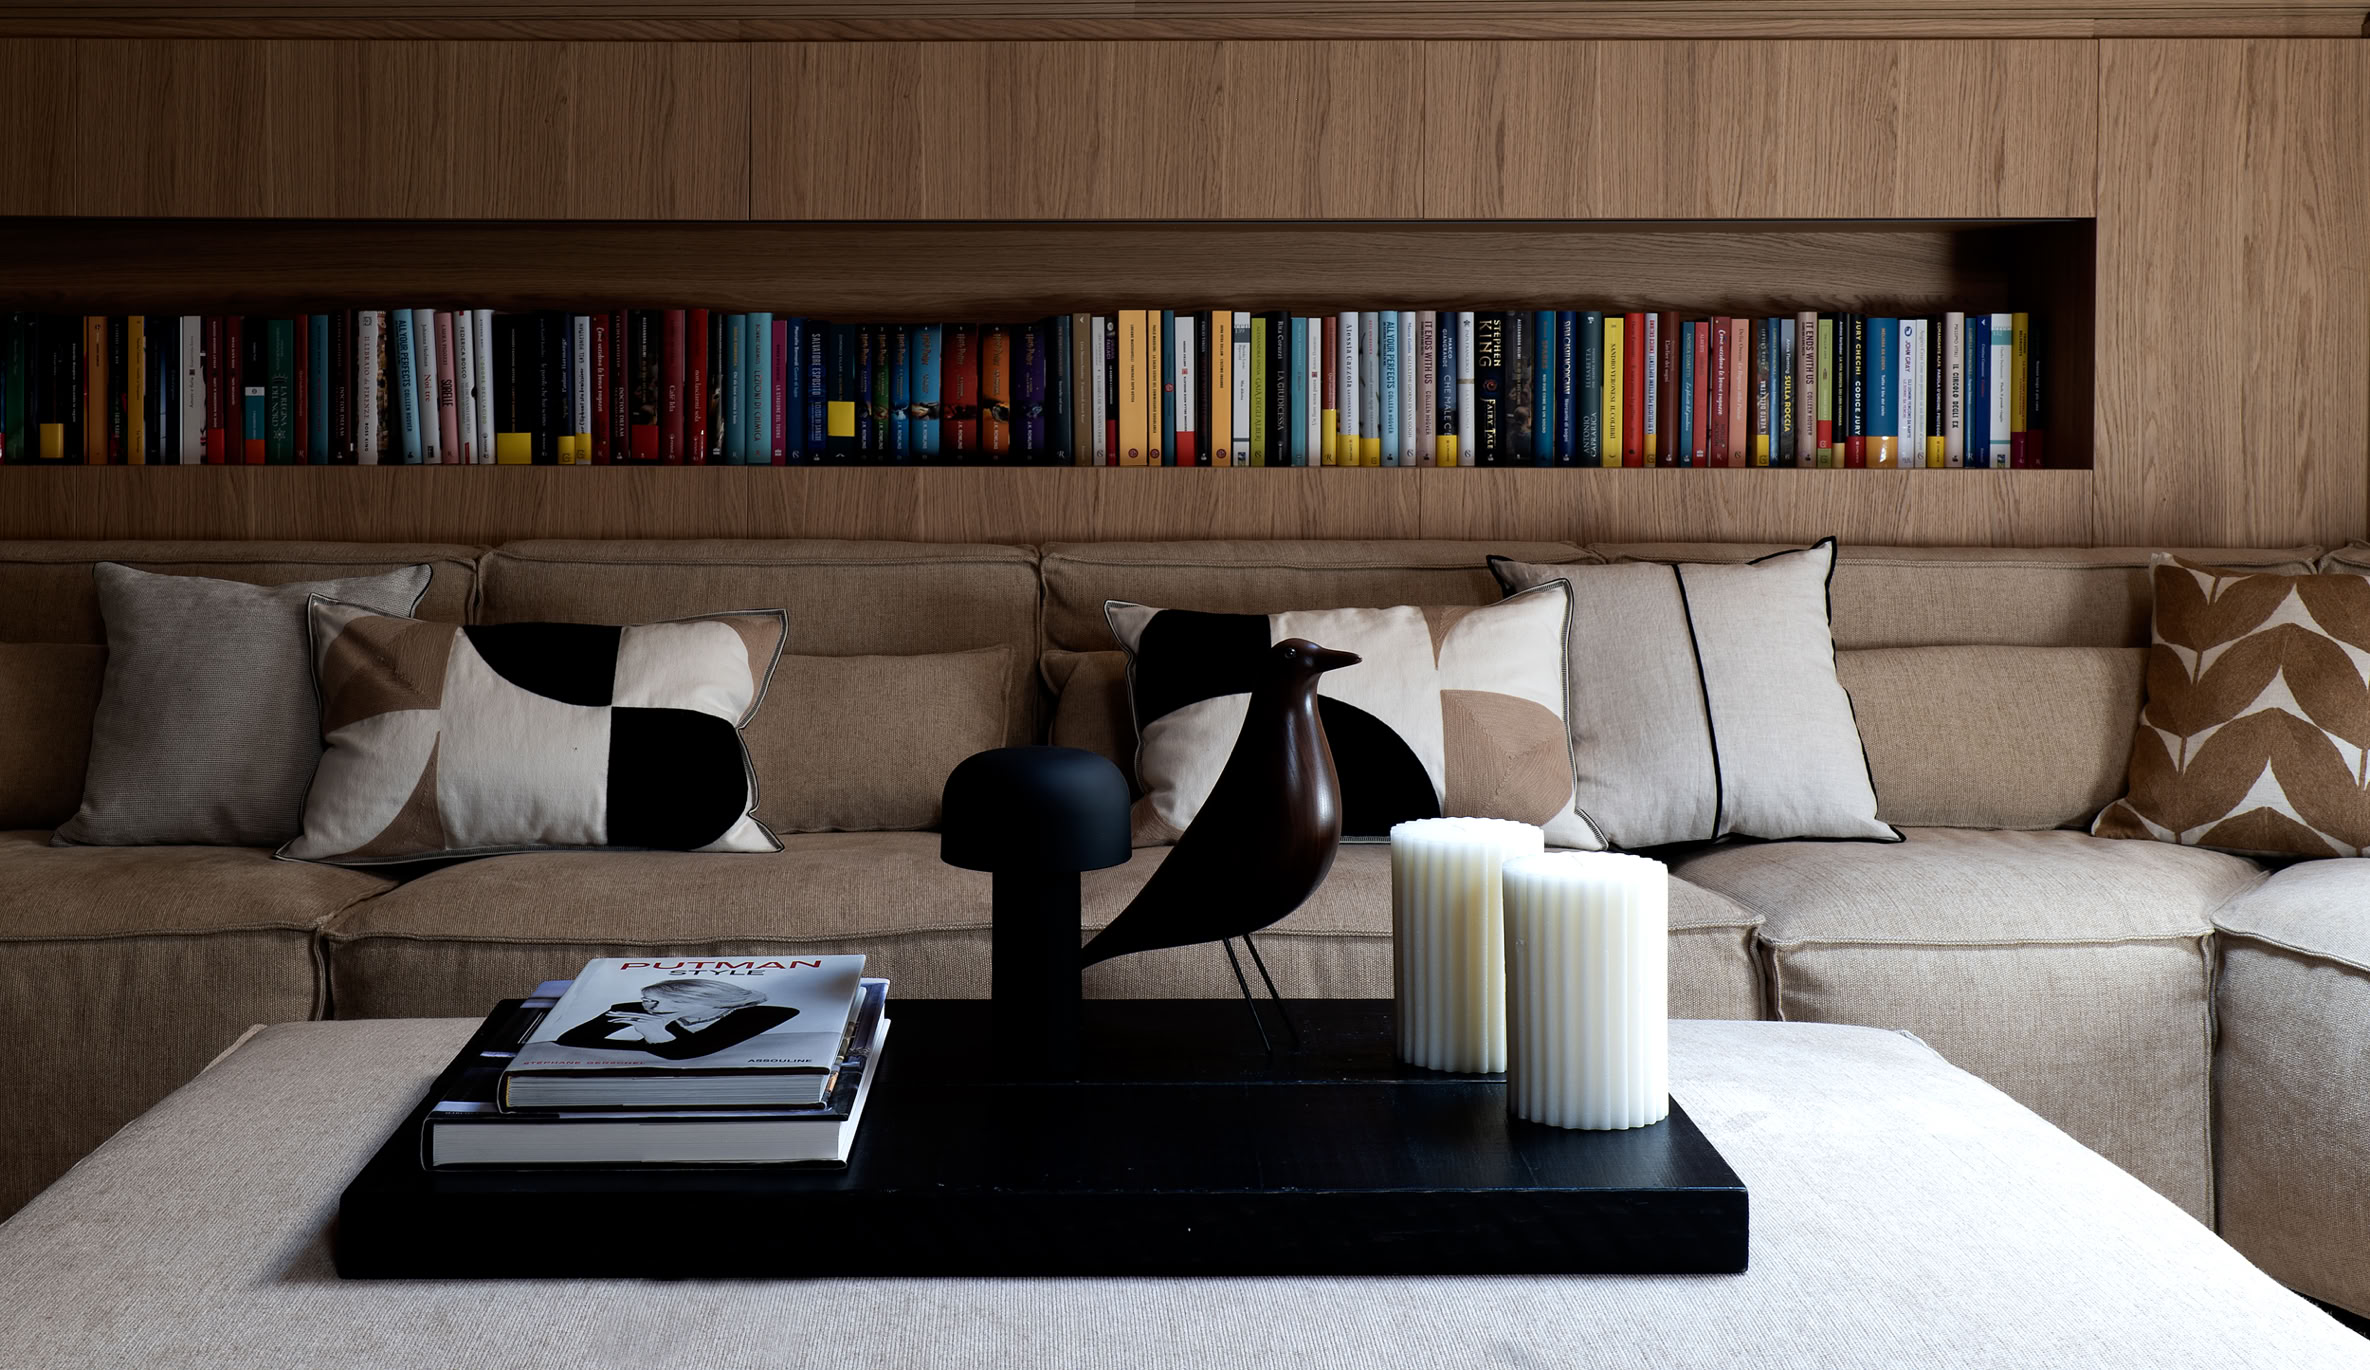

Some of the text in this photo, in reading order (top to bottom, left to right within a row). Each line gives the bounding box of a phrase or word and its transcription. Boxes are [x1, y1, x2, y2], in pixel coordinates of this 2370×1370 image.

[459, 326, 467, 356] FEDERICA
[1424, 330, 1433, 351] ENDS
[1479, 319, 1492, 368] KING
[1493, 319, 1502, 368] STEPHEN
[1718, 329, 1726, 345] Come
[1805, 330, 1814, 351] ENDS
[398, 320, 411, 387] ALL YOUR PERFECTS
[811, 333, 822, 396] SALVATORE ESPOSITO
[1386, 321, 1395, 389] ALL YOUR PERFECTS
[1424, 352, 1433, 372] WITH
[1805, 352, 1814, 372] WITH
[424, 374, 432, 389] Noi
[440, 379, 454, 408] SORELLE
[1254, 377, 1262, 396] GAIA
[1424, 373, 1433, 385] US
[1805, 374, 1814, 385] US
[280, 397, 288, 427] REGINA
[753, 369, 762, 442] LEZIONI DI CHIMICA
[1276, 370, 1285, 431] LA GIUDICESSA
[1443, 374, 1452, 421] CHE MALE
[271, 401, 279, 427] NORD
[1952, 420, 1959, 428] EX
[1582, 415, 1590, 454] ANTONIO
[1590, 412, 1598, 458] CAPRARICA
[620, 960, 822, 971] PUTMAN
